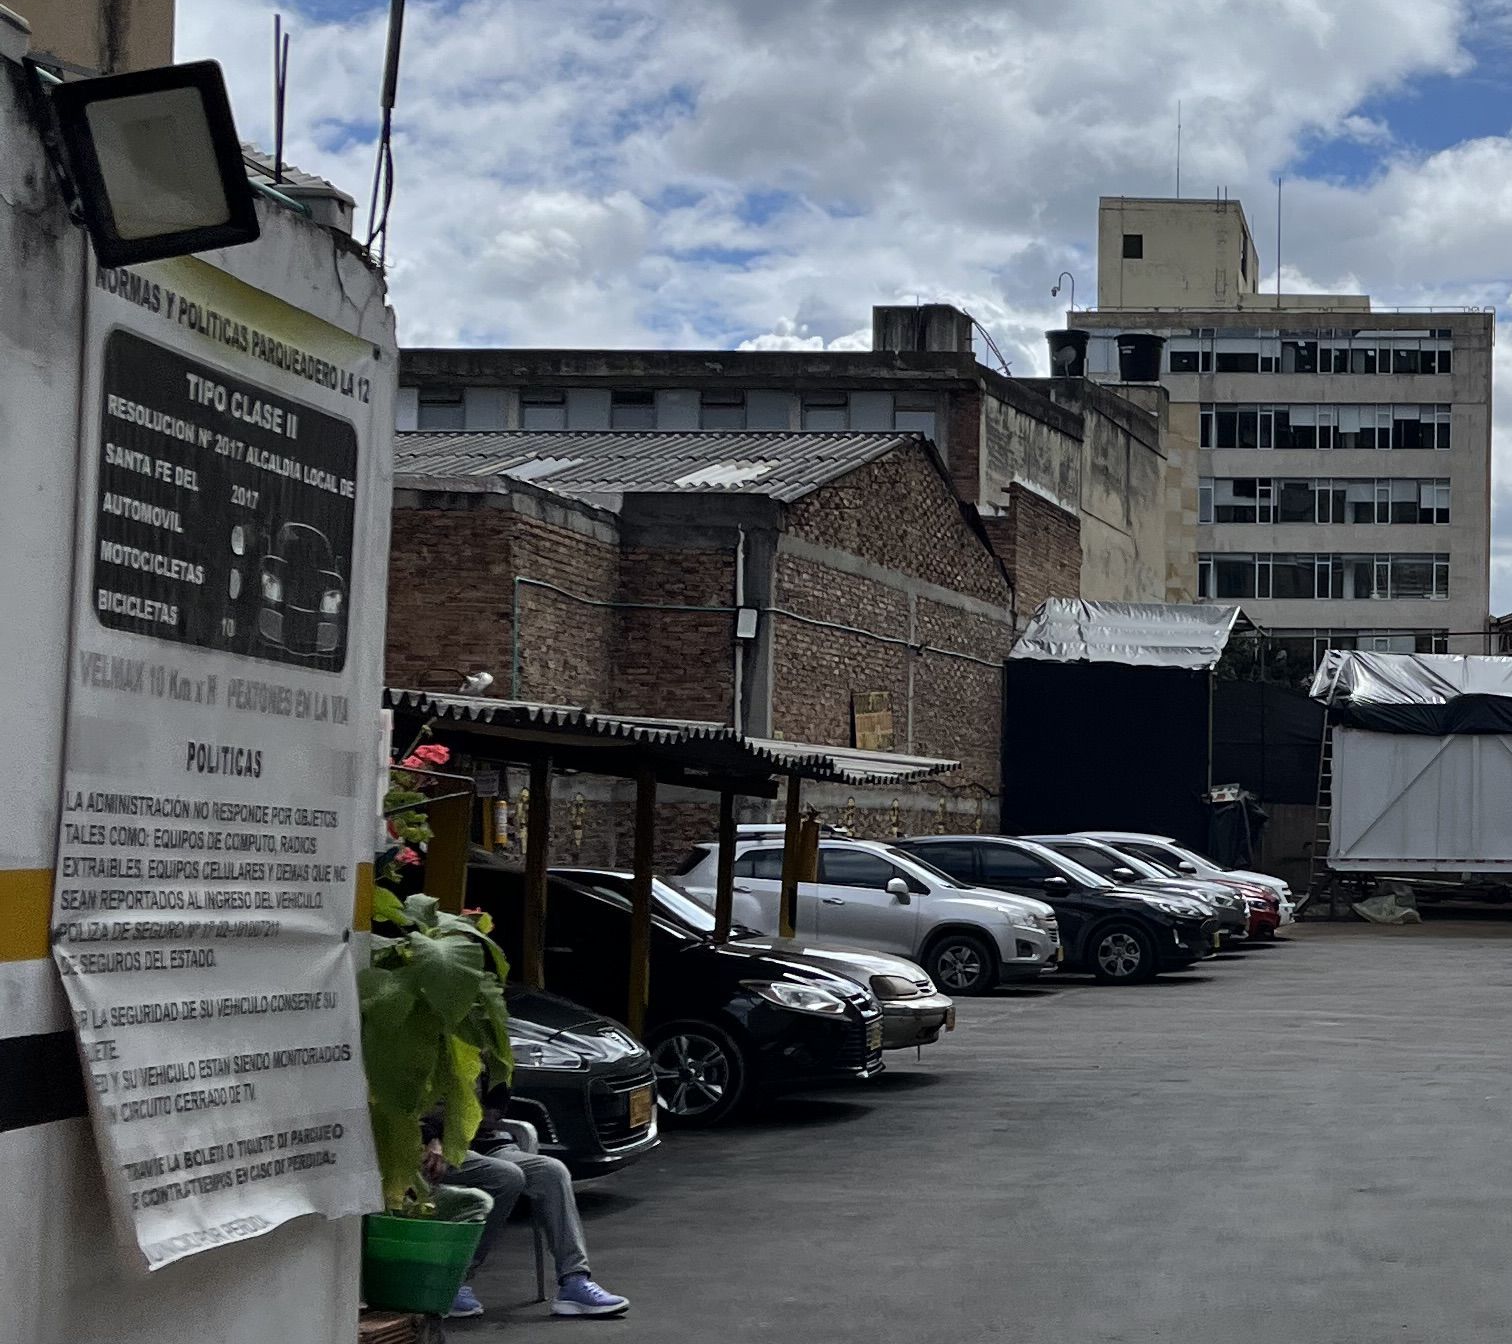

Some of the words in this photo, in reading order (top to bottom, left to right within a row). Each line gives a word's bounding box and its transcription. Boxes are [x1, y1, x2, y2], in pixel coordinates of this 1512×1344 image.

[96, 266, 161, 314] NORMAS
[164, 288, 176, 320] Y
[178, 296, 249, 353] POLITICAS
[251, 329, 338, 391] PARQUEADERO
[340, 369, 355, 398] LA
[358, 377, 371, 404] 12
[186, 371, 227, 413] TIPO
[230, 391, 284, 435] CLASE
[286, 412, 298, 441] II
[107, 393, 195, 444] RESOLUCION
[214, 433, 245, 460] 2017
[303, 464, 339, 494] LOCAL
[340, 478, 355, 499] DE
[105, 442, 151, 478] SANTA
[154, 460, 173, 484] FE
[175, 466, 200, 492] DEL
[102, 491, 184, 534] AUTOMOVIL
[231, 484, 260, 510] 2017
[100, 540, 205, 585] MOTOCICLETAS
[97, 588, 178, 626] BICICLETAS
[186, 740, 262, 778] POLITICAS
[65, 790, 84, 812] LA
[193, 802, 209, 820] NO
[212, 801, 269, 824] RESPONDE
[272, 805, 292, 826] POR
[294, 807, 339, 828] OBJETOS
[64, 823, 106, 845] TALES
[153, 828, 204, 850] EQUIPOS
[206, 830, 223, 850] DE
[148, 859, 199, 879] EQUIPOS
[202, 860, 265, 881] CELULARES
[267, 862, 275, 882] Y
[275, 862, 310, 882] DEMAS
[311, 864, 332, 882] QUE
[60, 889, 97, 911] SEAN
[100, 889, 184, 910] REPORTADOS
[187, 890, 202, 910] AL
[204, 890, 252, 910] INGRESO
[254, 891, 272, 910] DEL
[111, 922, 131, 942] DE
[132, 921, 185, 941] SEGURO
[79, 951, 141, 975] SEGUROS
[144, 949, 167, 971] DEL
[110, 1005, 179, 1027] SEGURIDAD
[182, 1000, 197, 1021] DE
[200, 999, 214, 1019] SU
[216, 995, 268, 1017] VEHICULO
[270, 992, 321, 1012] CONSERVE
[122, 1068, 138, 1090] SU
[139, 1060, 197, 1087] VEHICULO
[199, 1056, 231, 1080] ESTAN
[233, 1052, 270, 1074] SIENDO
[120, 1095, 171, 1123] CIRCUITO
[174, 1088, 229, 1114] CERRADO
[230, 1085, 241, 1105] DE
[167, 1155, 180, 1174] LA
[290, 1123, 345, 1147] PARQUEO
[235, 1165, 249, 1186] EN
